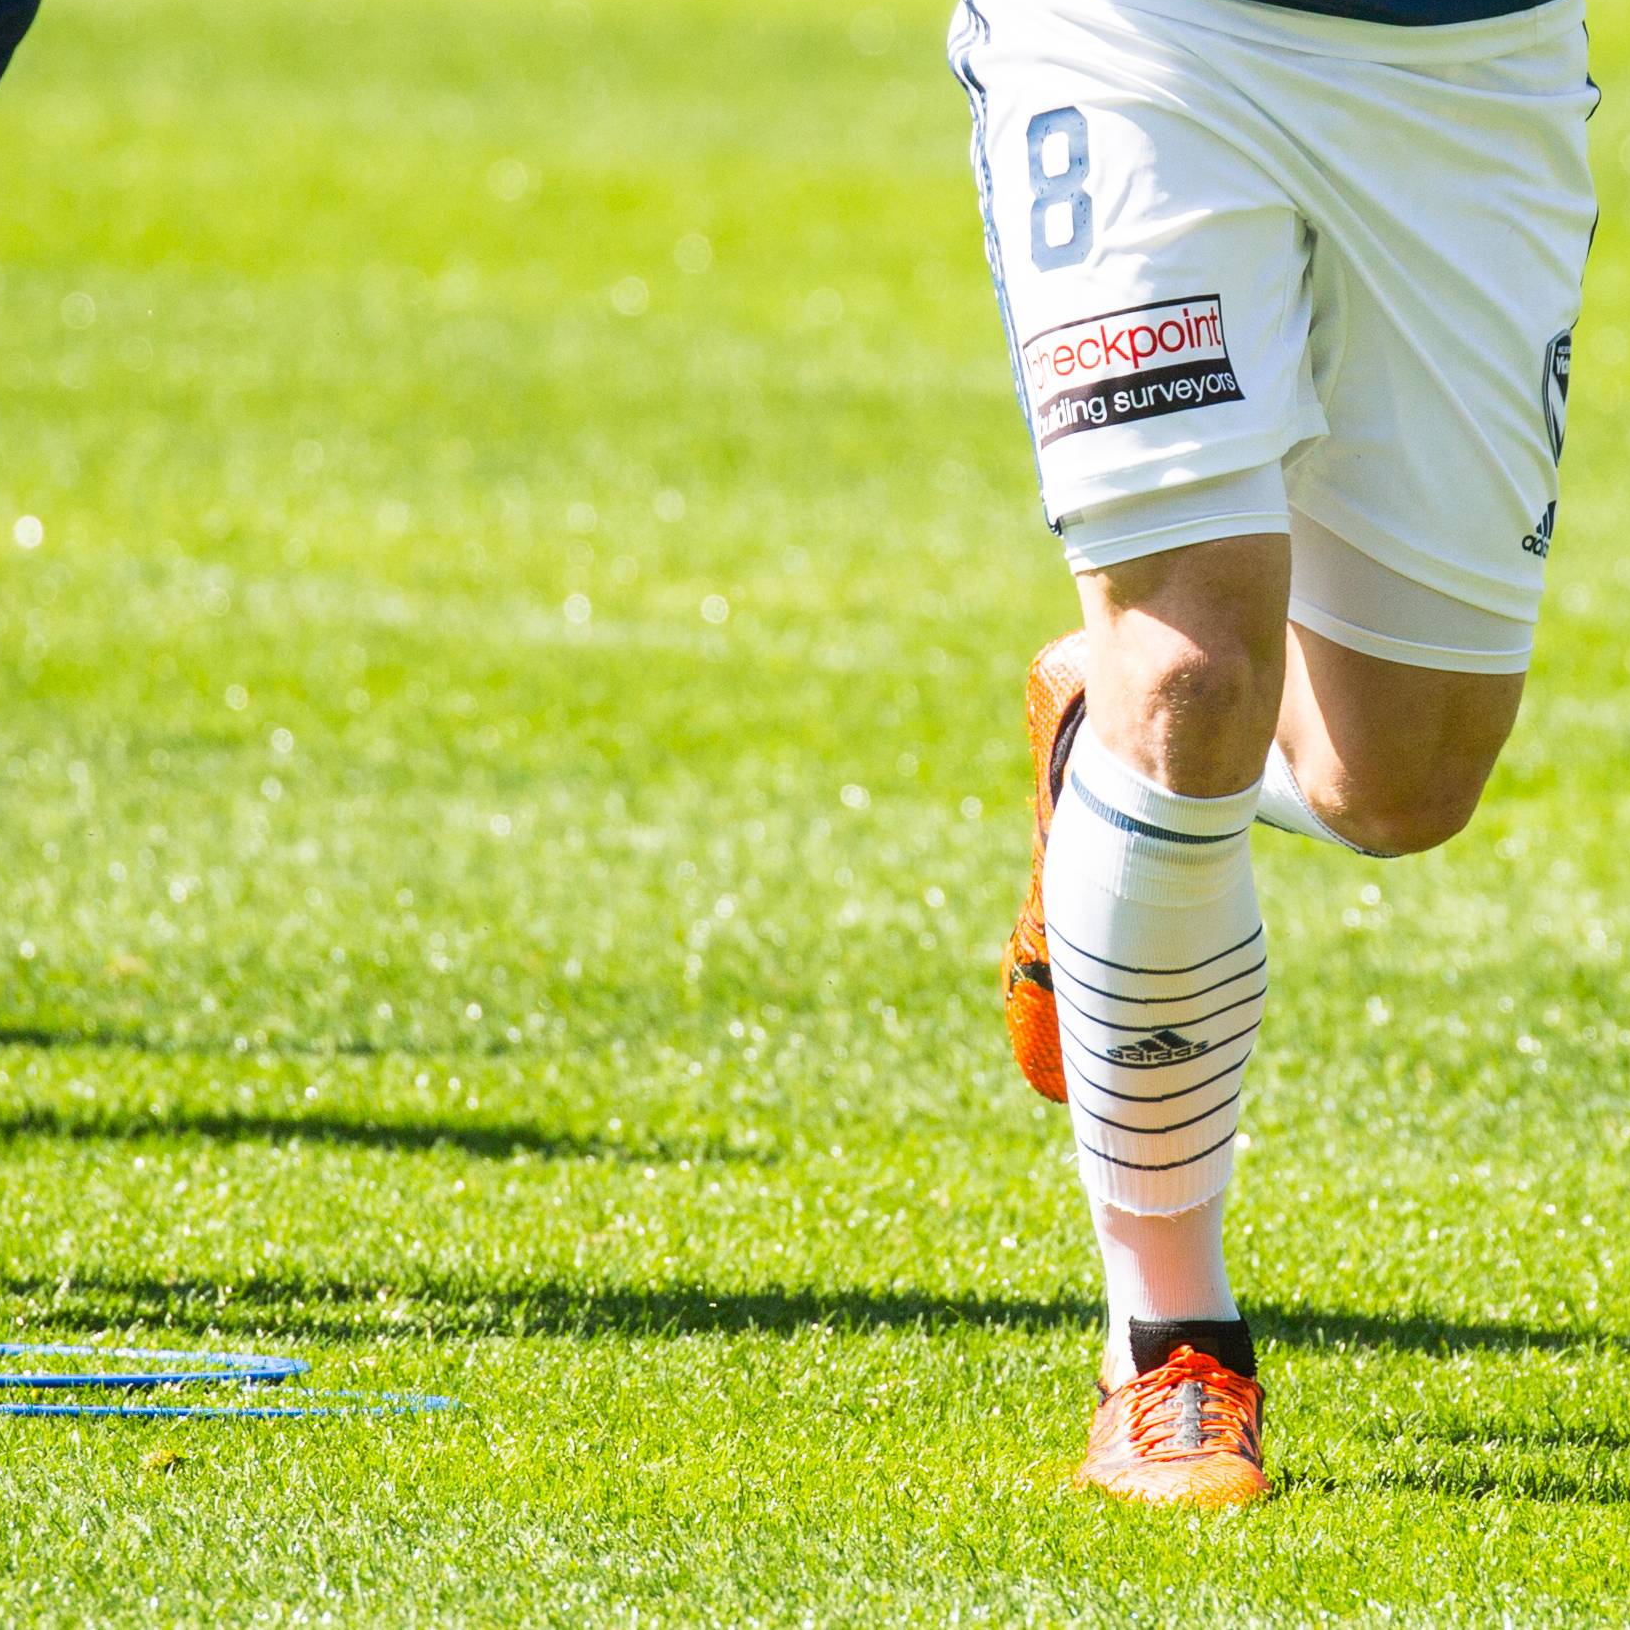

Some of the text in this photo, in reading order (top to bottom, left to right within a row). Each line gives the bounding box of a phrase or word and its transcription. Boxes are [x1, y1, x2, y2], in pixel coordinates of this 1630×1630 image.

[1025, 104, 1095, 273] 8
[1031, 306, 1223, 390] checkpoint
[1113, 371, 1237, 414] surveyors
[1105, 1040, 1209, 1063] adidas
